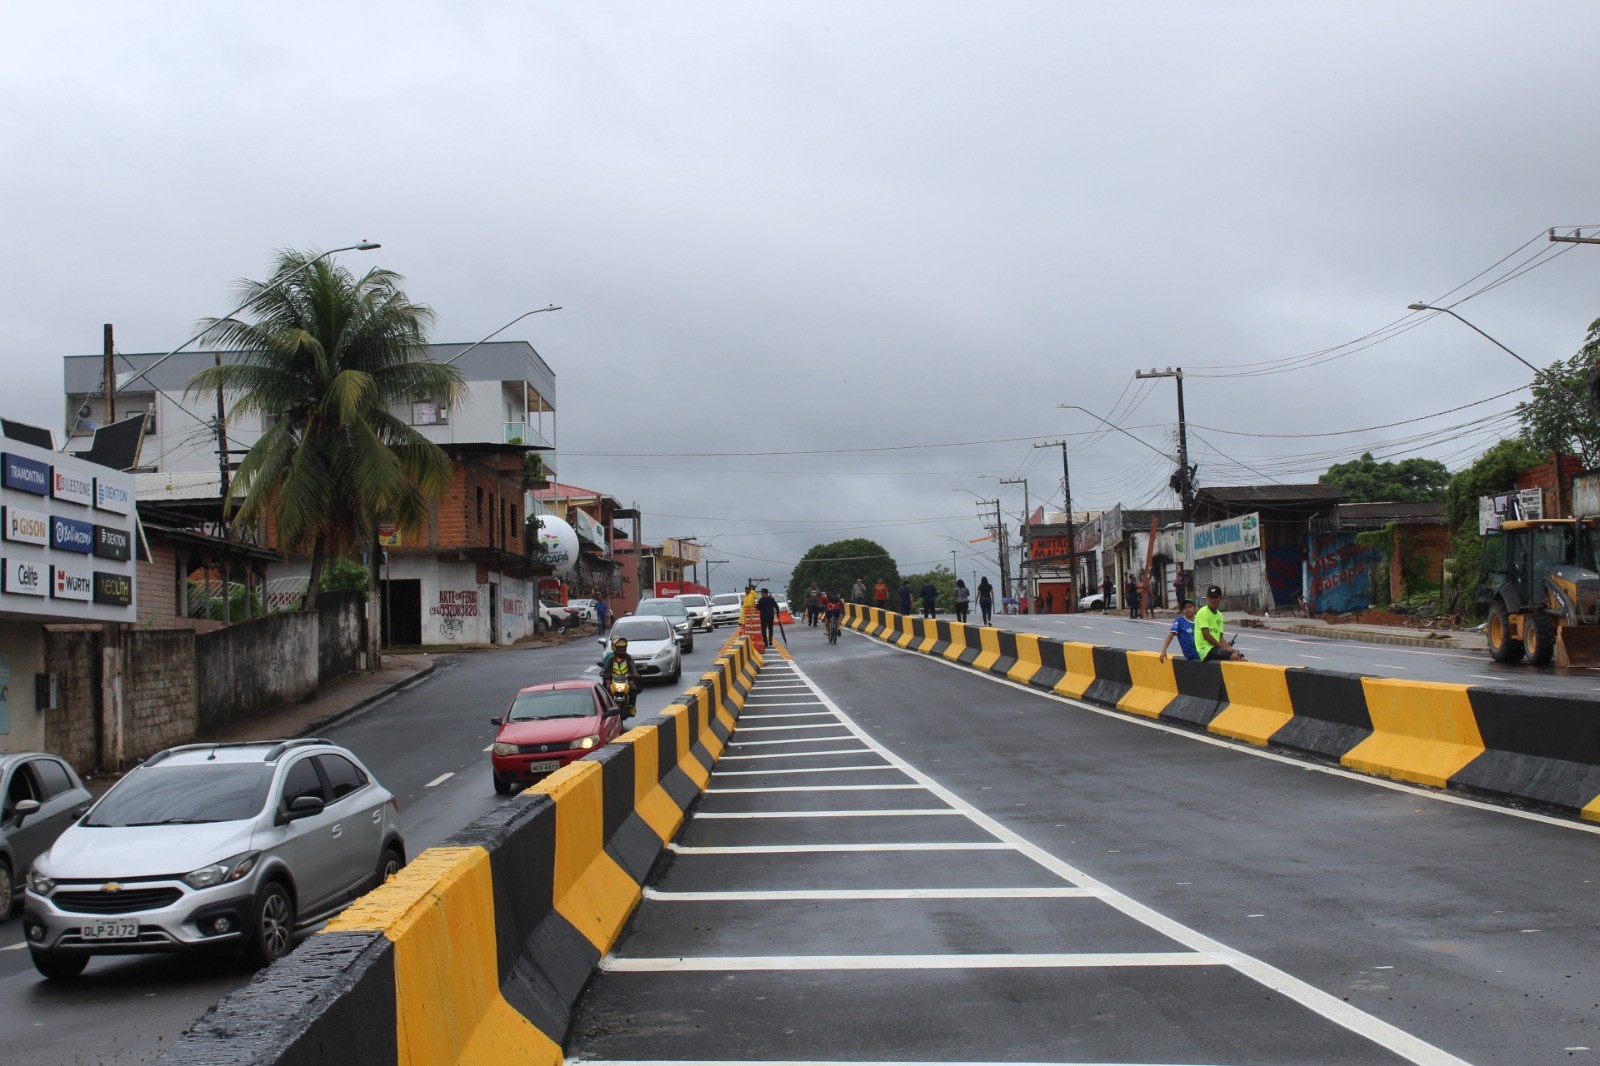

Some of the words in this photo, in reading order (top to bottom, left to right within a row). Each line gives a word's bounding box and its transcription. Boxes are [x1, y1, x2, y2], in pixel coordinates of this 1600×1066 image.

[11, 465, 45, 485] TRAMONTINA
[61, 476, 91, 497] SILESTONE
[105, 485, 128, 503] DEKTON
[20, 518, 46, 538] GISON
[107, 532, 126, 547] DEKTON
[18, 564, 38, 587] Celite
[439, 590, 455, 603] ARTE
[462, 590, 477, 603] FERRO
